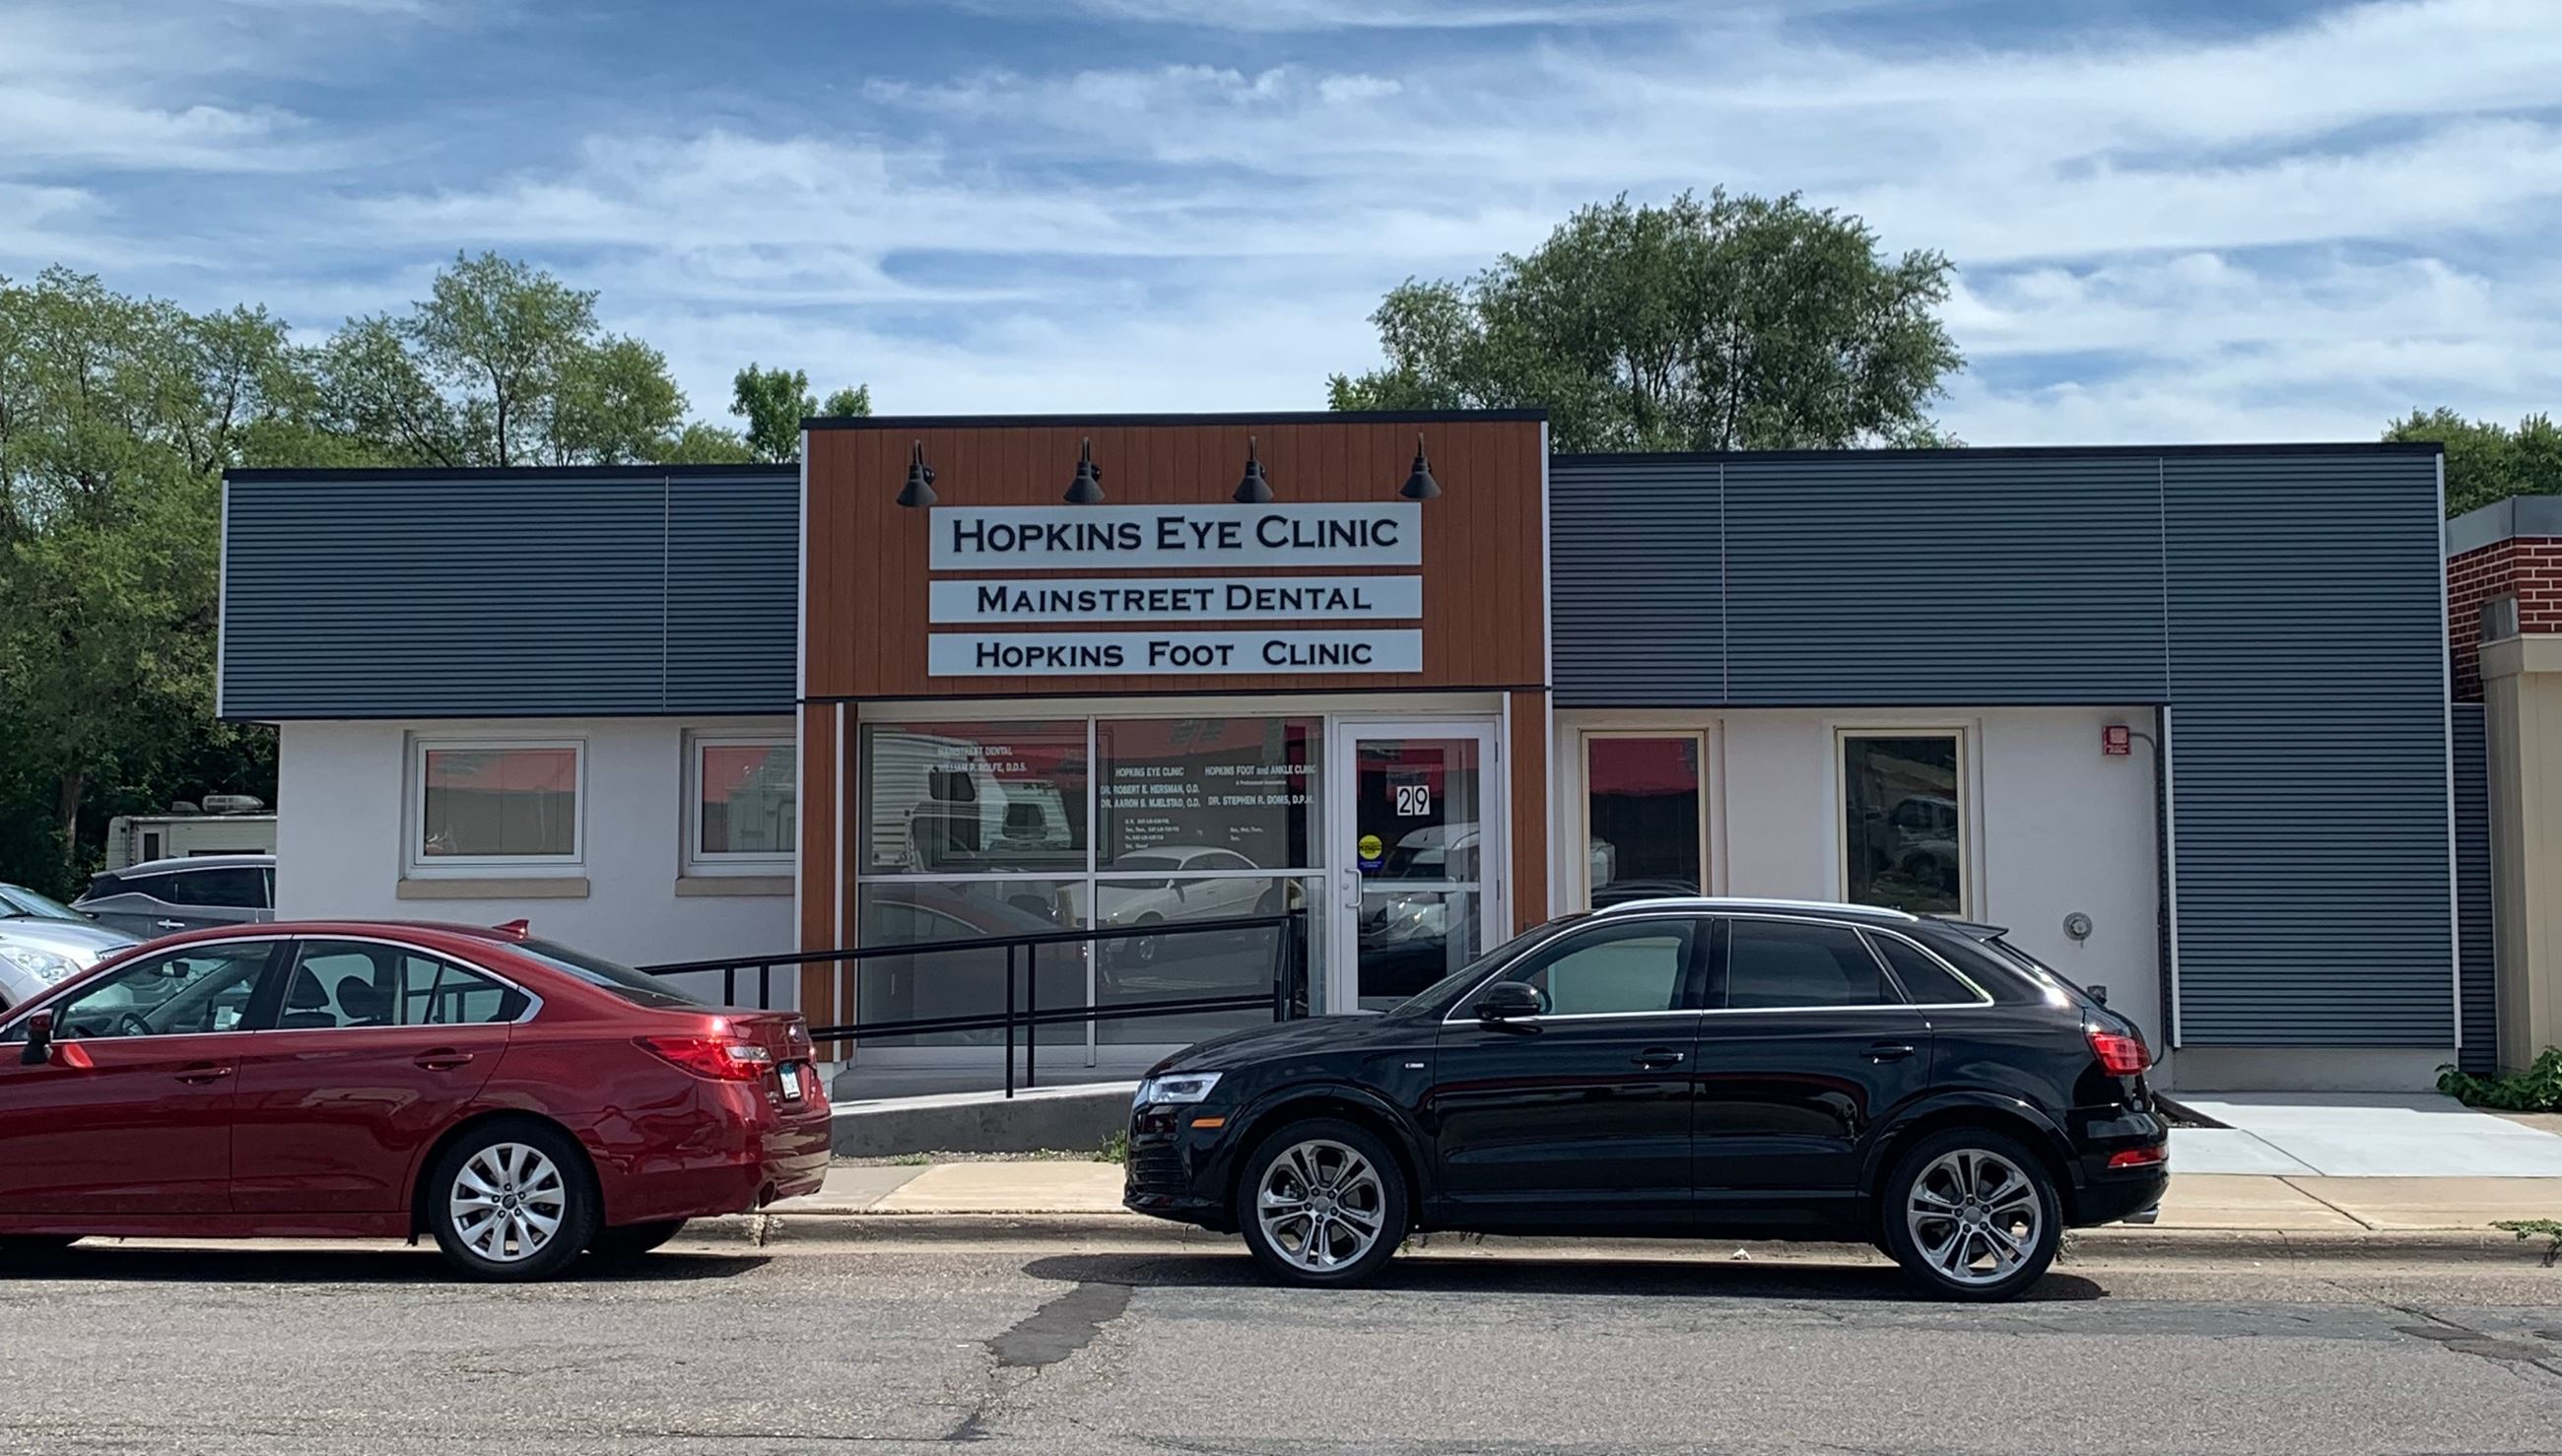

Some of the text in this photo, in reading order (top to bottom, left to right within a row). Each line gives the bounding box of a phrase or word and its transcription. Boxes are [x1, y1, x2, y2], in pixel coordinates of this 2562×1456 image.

[952, 515, 1399, 553] HOPKINS EYE CLINIC
[977, 584, 1372, 613] MAINSTREET DENTAL
[976, 640, 1373, 668] HOPKINS FOOT CLINIC
[985, 746, 1013, 757] DENTAL
[1006, 761, 1028, 772] D.D.S.
[1114, 766, 1184, 777] HOPKINS EYE CLINIC
[1204, 764, 1316, 776] HOPKINS FOOT and ANKLE CLINIC
[1100, 785, 1112, 795] DR.
[1113, 784, 1141, 795] ROBERT
[1185, 783, 1200, 794] O.D.
[1101, 798, 1112, 809] DR.
[1113, 798, 1139, 808] AARON
[1186, 798, 1201, 808] O.D.
[1207, 796, 1221, 806] DR.
[1223, 795, 1256, 806] STEPHEN
[1398, 786, 1428, 814] 29
